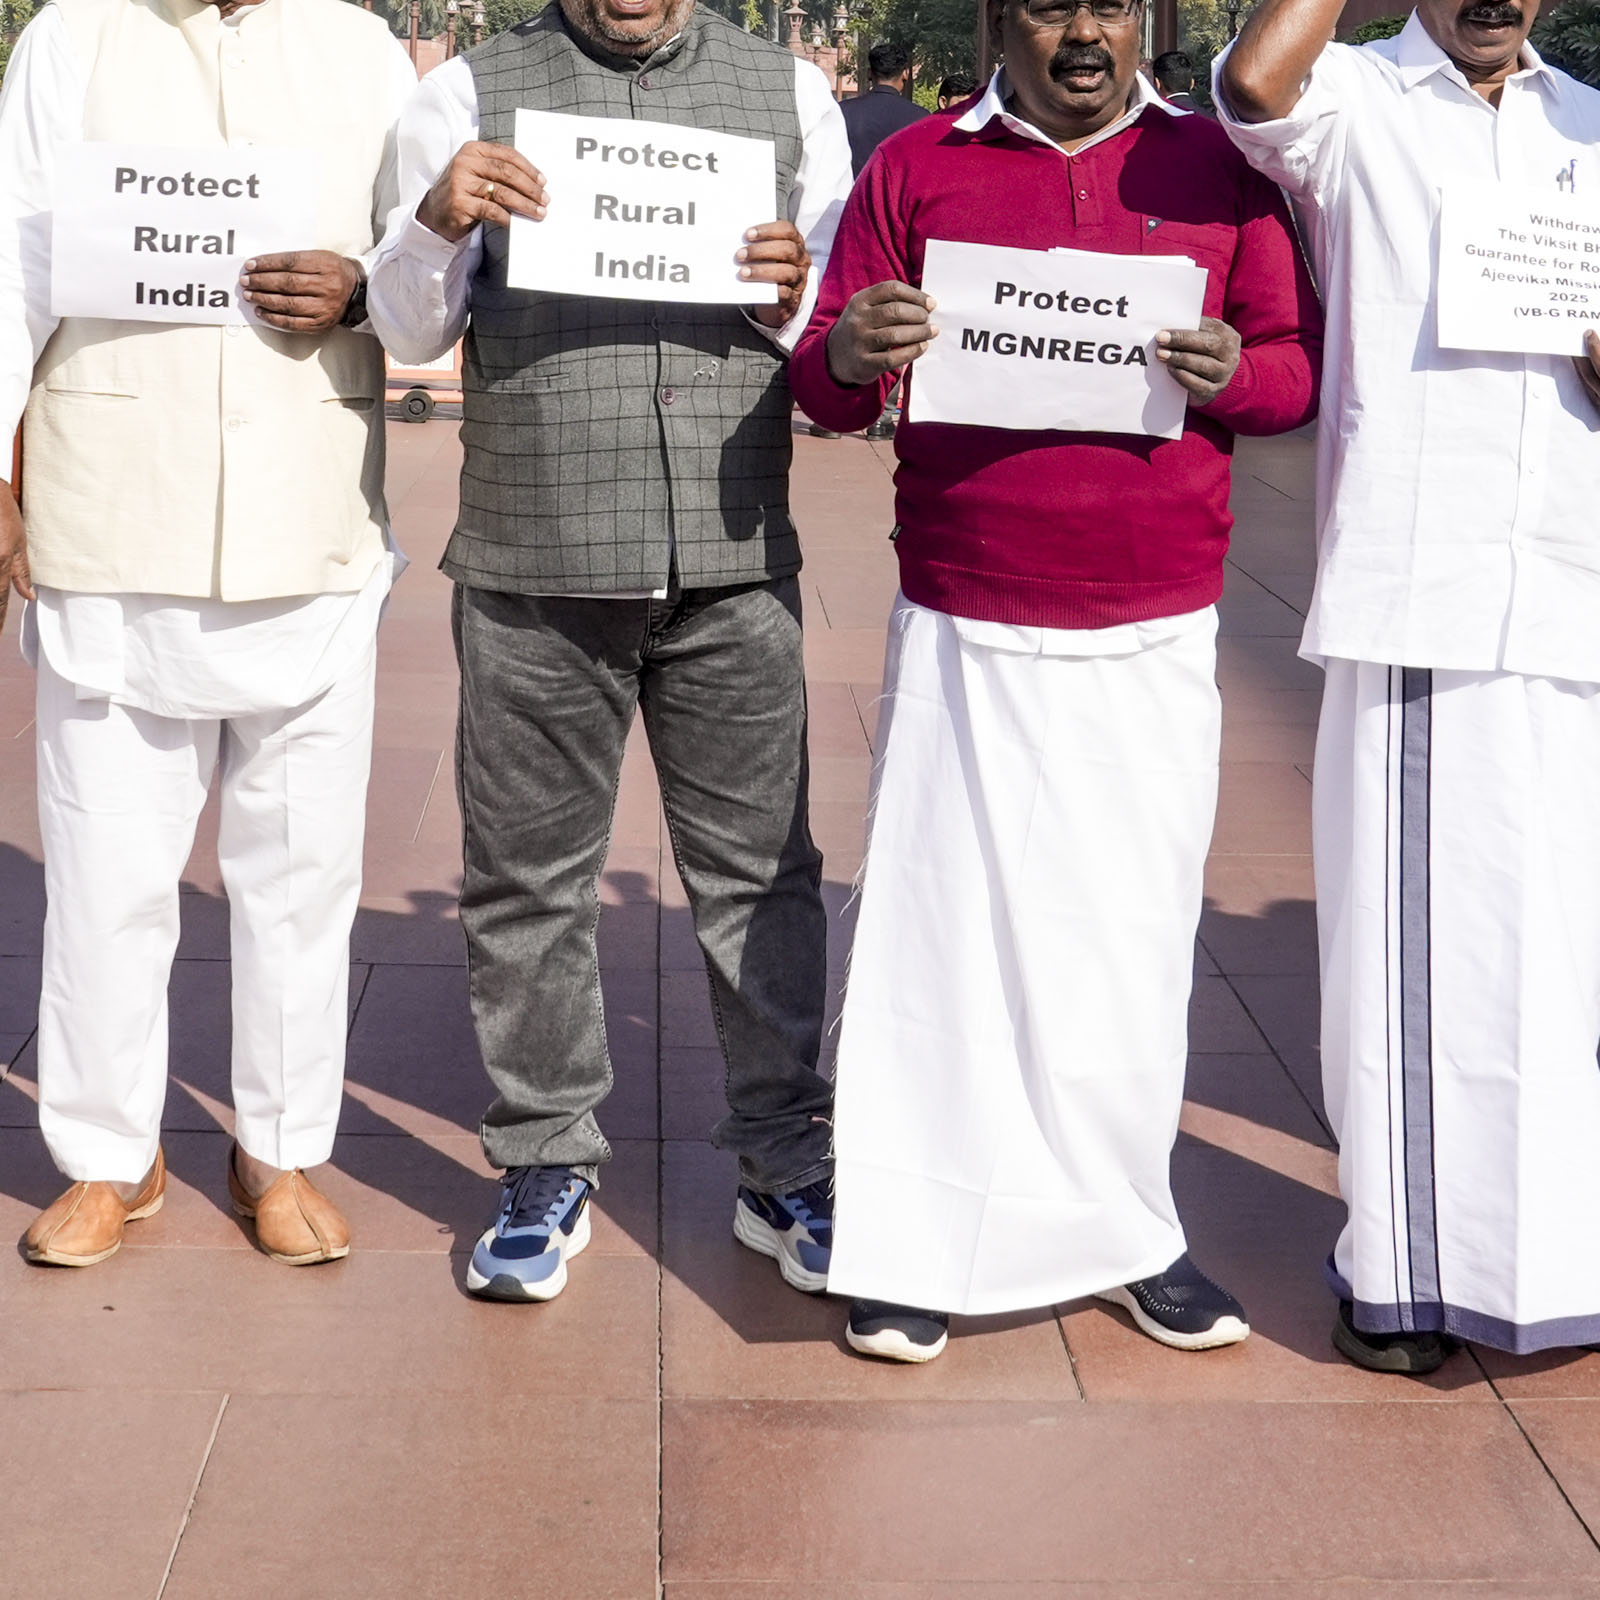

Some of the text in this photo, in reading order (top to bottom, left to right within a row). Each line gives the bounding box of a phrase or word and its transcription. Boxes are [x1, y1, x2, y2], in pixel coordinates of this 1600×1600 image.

[576, 137, 718, 173] Protect
[115, 167, 259, 198] Protect
[594, 194, 695, 225] Rural
[134, 226, 235, 255] Rural
[1498, 228, 1526, 242] The
[1533, 234, 1577, 251] Viksit
[595, 252, 689, 283] India
[1465, 244, 1547, 266] Guarantee
[1553, 258, 1574, 270] for
[1481, 268, 1549, 284] Ajeevika
[136, 282, 229, 307] India
[995, 282, 1128, 317] Protect
[1550, 292, 1588, 303] 2025
[1514, 307, 1560, 317] (VB-G
[961, 328, 1148, 366] MGNREGA
